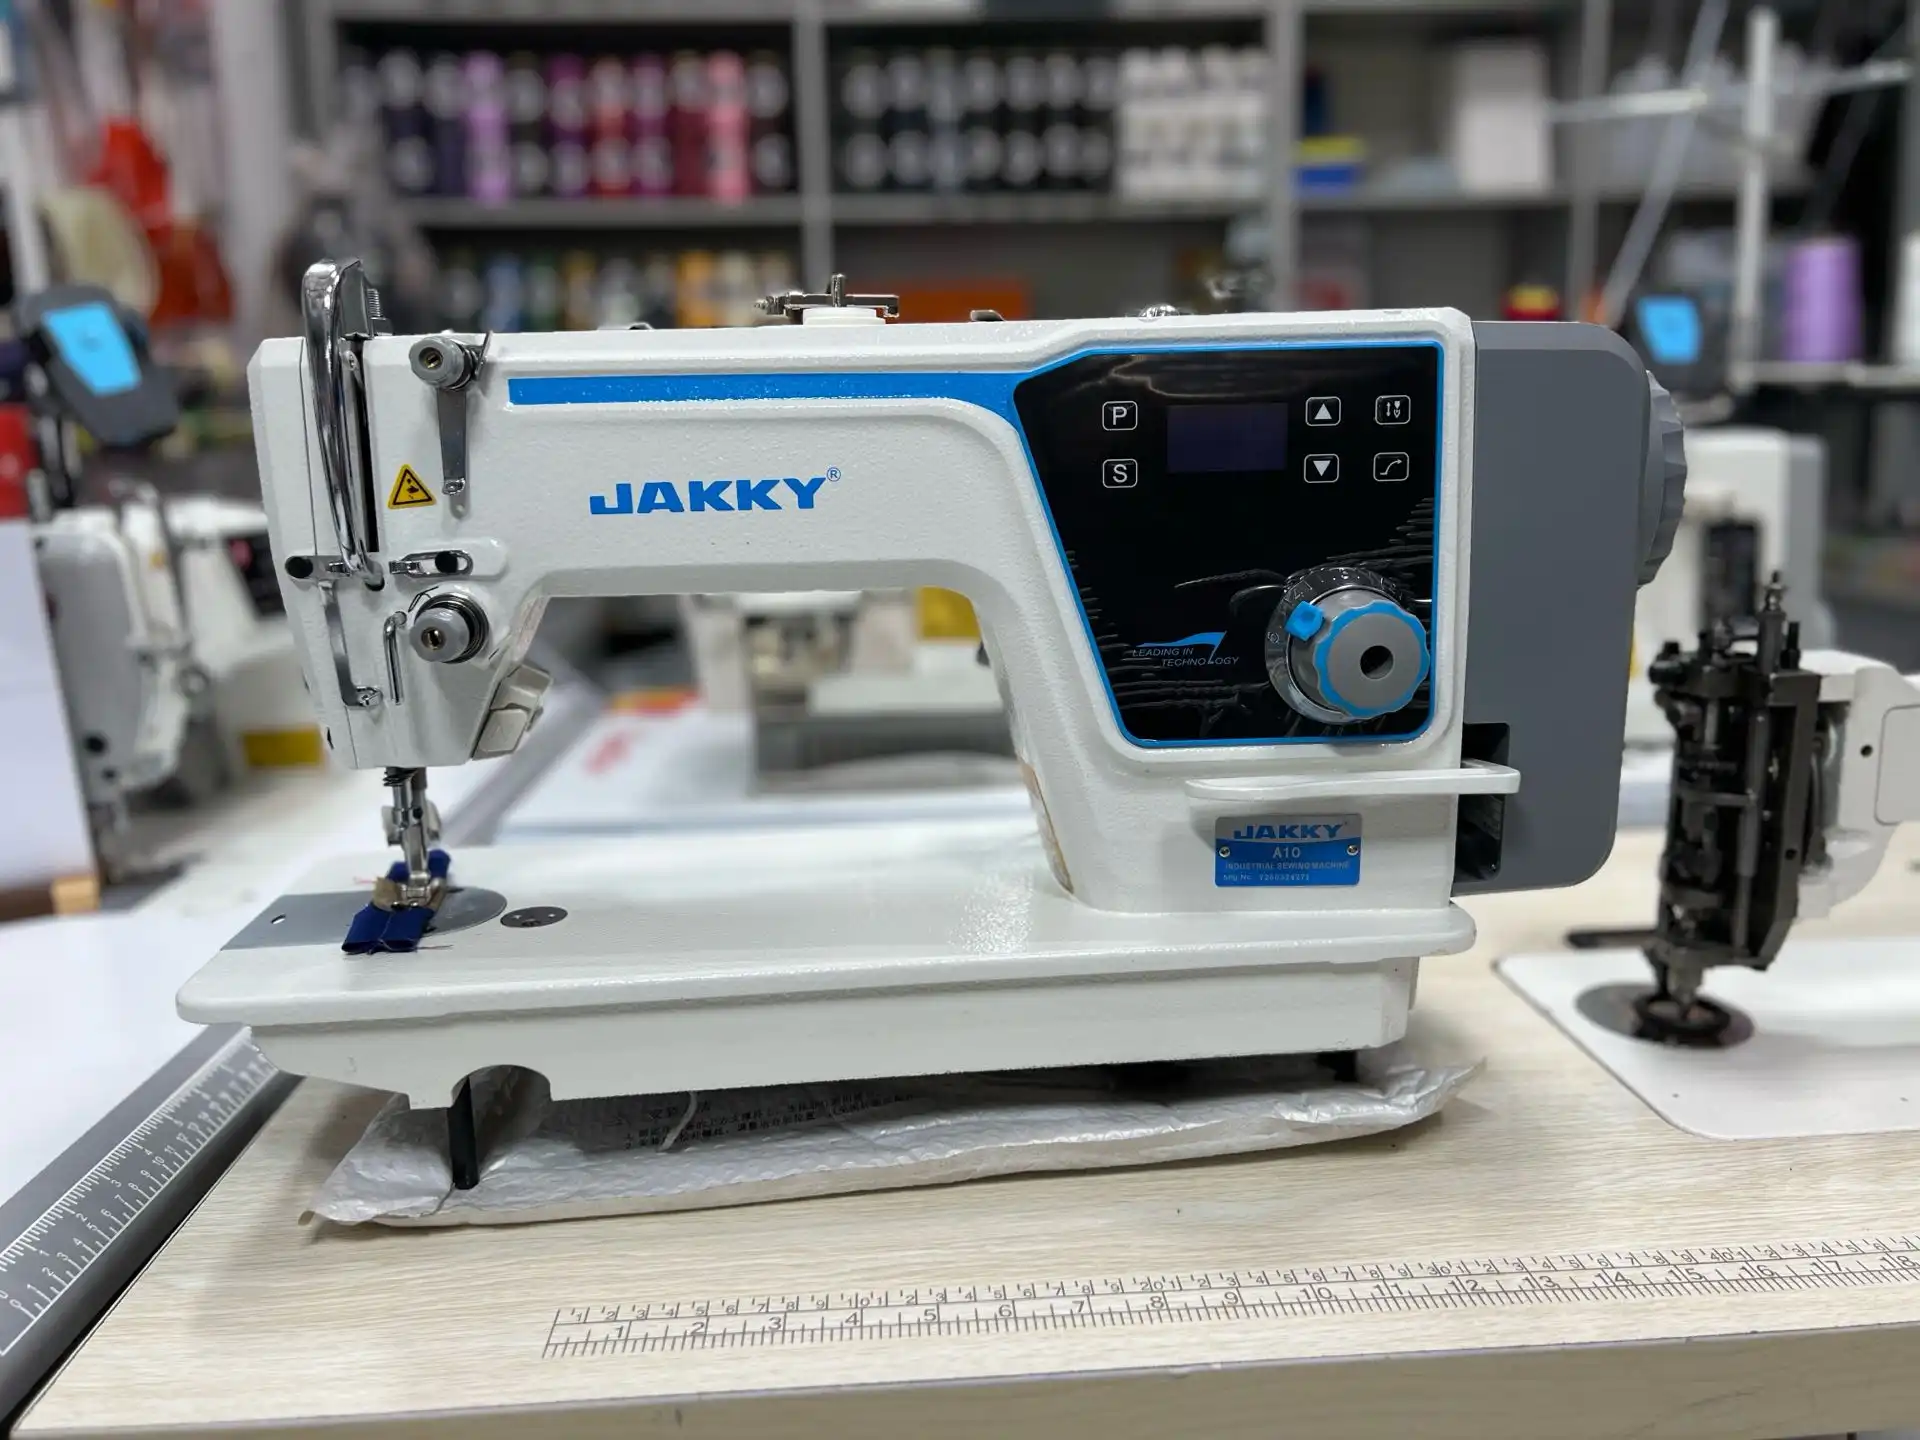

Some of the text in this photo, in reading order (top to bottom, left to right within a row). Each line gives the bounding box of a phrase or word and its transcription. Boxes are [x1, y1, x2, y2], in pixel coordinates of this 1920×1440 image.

[1113, 406, 1127, 425] P
[1113, 463, 1128, 483] S
[589, 477, 826, 515] JAKKY
[1132, 648, 1194, 657] LEADING IN
[1161, 656, 1239, 667] TECHNOLOGY
[1233, 824, 1343, 839] JAKKY
[1273, 847, 1301, 859] A10
[9, 1299, 20, 1308] 0
[42, 1266, 54, 1276] 2
[57, 1252, 68, 1261] 3
[73, 1237, 82, 1246] 4
[86, 1222, 98, 1231] 5
[100, 1208, 111, 1217] 6
[114, 1194, 123, 1202] 7
[127, 1182, 139, 1190] 8
[140, 1169, 151, 1178] 9
[606, 1311, 615, 1320] 2
[637, 1310, 646, 1320] 3
[666, 1309, 674, 1317] 4
[696, 1306, 705, 1316] 5
[726, 1305, 735, 1314] 6
[758, 1303, 767, 1312] 7
[786, 1301, 795, 1310] 8
[816, 1300, 825, 1309] 9
[906, 1295, 914, 1304] 2
[935, 1292, 944, 1301] 3
[965, 1291, 973, 1300] 4
[994, 1290, 1002, 1299] 5
[1023, 1289, 1032, 1297] 6
[1052, 1287, 1061, 1296] 7
[1081, 1284, 1090, 1294] 8
[1110, 1283, 1120, 1293] 9
[1198, 1278, 1208, 1288] 2
[1226, 1276, 1236, 1286] 3
[1256, 1275, 1265, 1284] 4
[1283, 1273, 1293, 1283] 5
[1312, 1272, 1322, 1282] 6
[1341, 1271, 1349, 1280] 7
[1370, 1269, 1380, 1279] 8
[1398, 1268, 1408, 1277] 9
[1483, 1263, 1494, 1272] 2
[1513, 1262, 1524, 1271] 3
[1542, 1260, 1551, 1269] 4
[1569, 1259, 1580, 1268] 5
[1597, 1258, 1608, 1267] 6
[1625, 1257, 1634, 1265] 7
[1653, 1255, 1665, 1264] 8
[1681, 1254, 1692, 1262] 9
[616, 1255, 1916, 1338] 1 2 3 4 5 6 7 8 9 10 11 12 13 14 15 16 17 18
